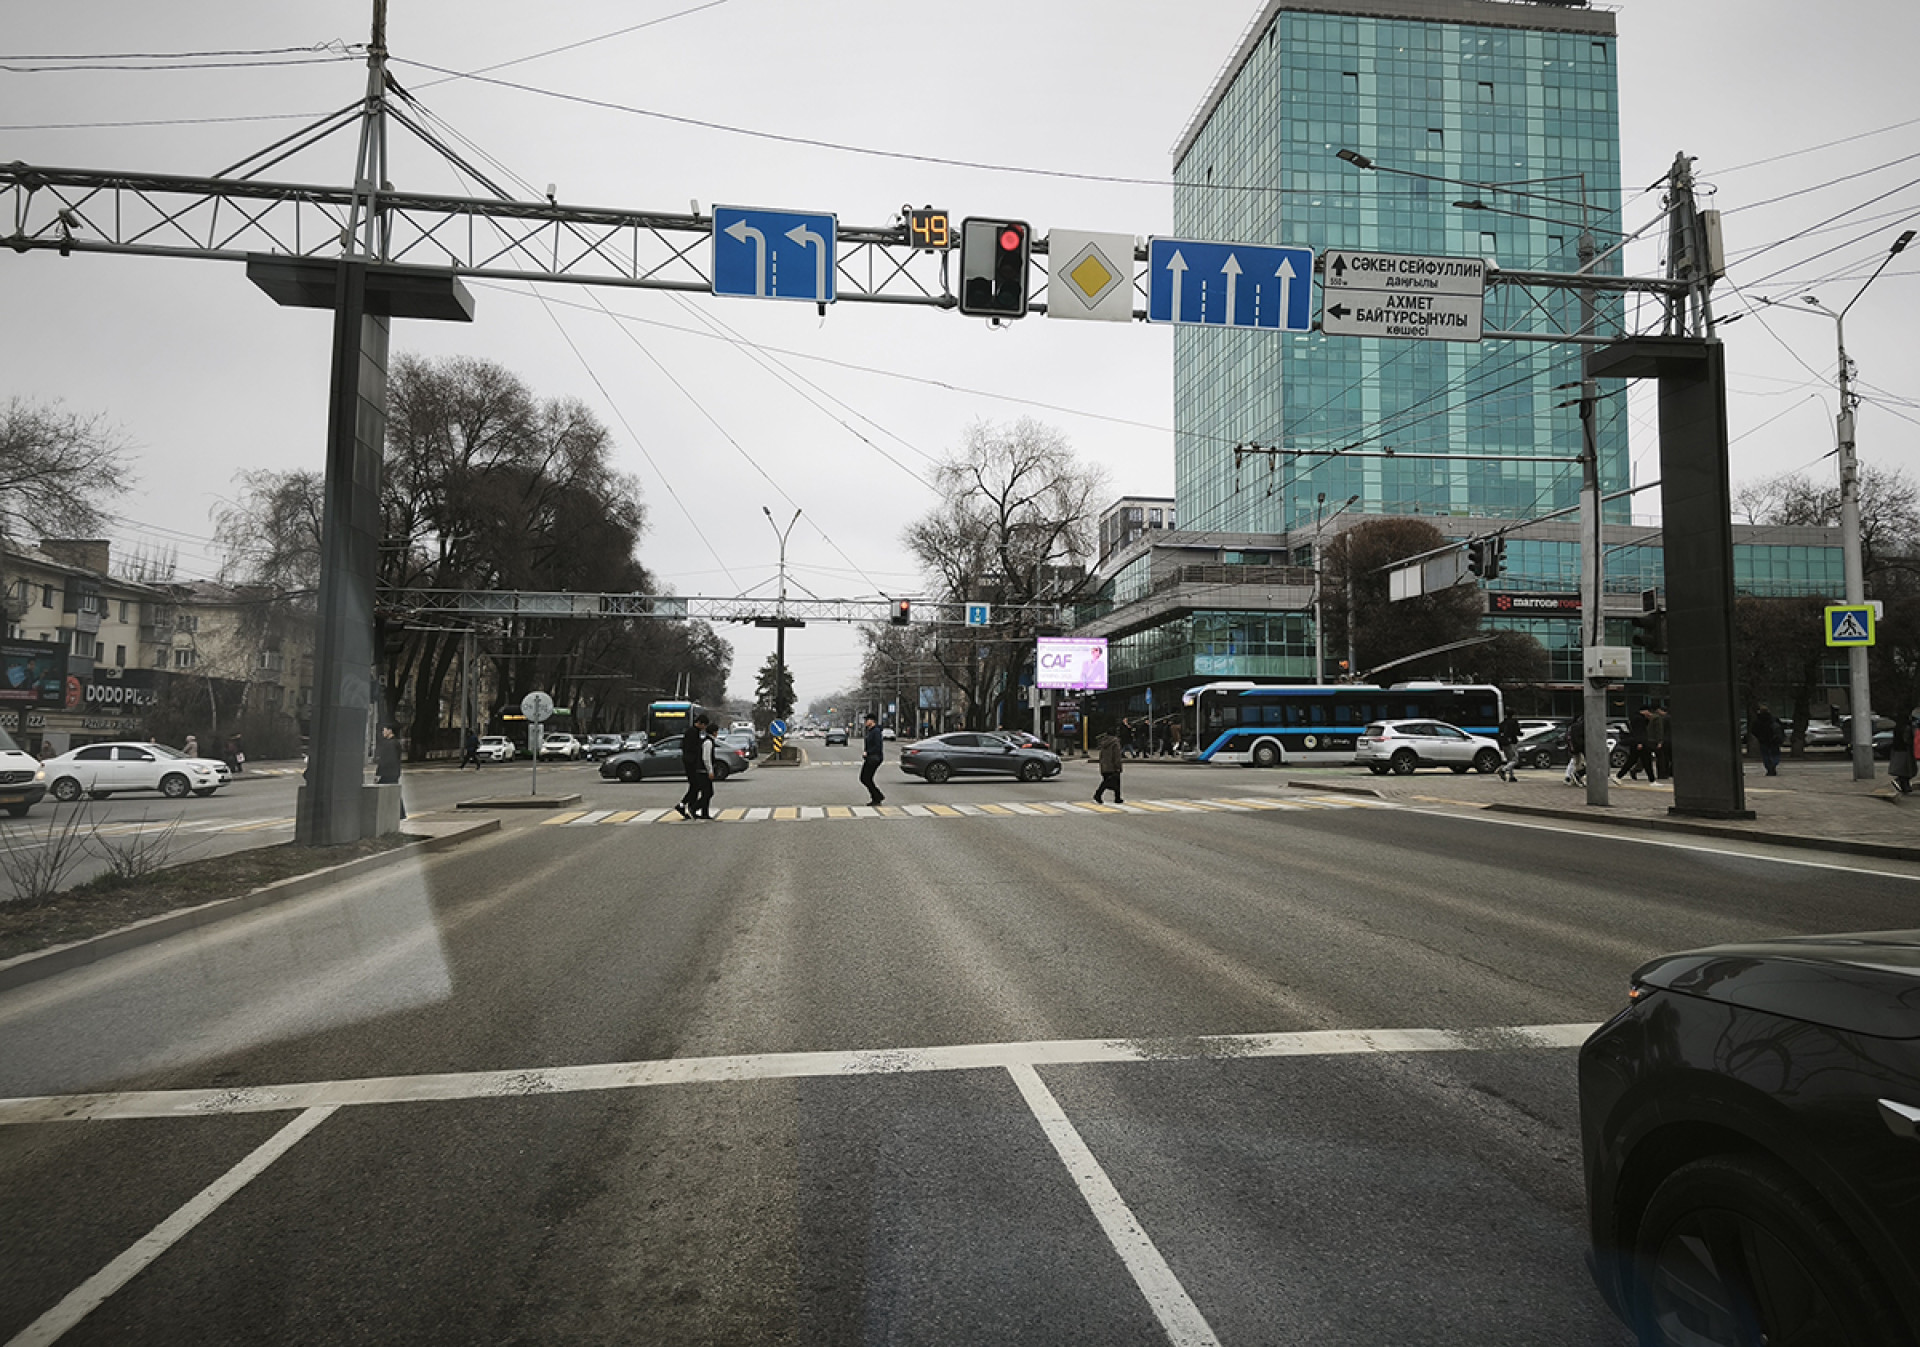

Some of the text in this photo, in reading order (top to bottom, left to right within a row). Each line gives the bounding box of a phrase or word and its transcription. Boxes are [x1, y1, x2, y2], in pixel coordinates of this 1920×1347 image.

[912, 215, 947, 246] 49
[1351, 257, 1481, 278] СӘКЕН СЕЙФУЛЛИН
[1386, 295, 1435, 310] АХМЕТ
[1356, 308, 1468, 327] БАЙТҰРСЫНҰЛЫ
[1386, 325, 1429, 337] көшесі
[1041, 653, 1072, 668] CAF
[86, 684, 123, 703] DODO
